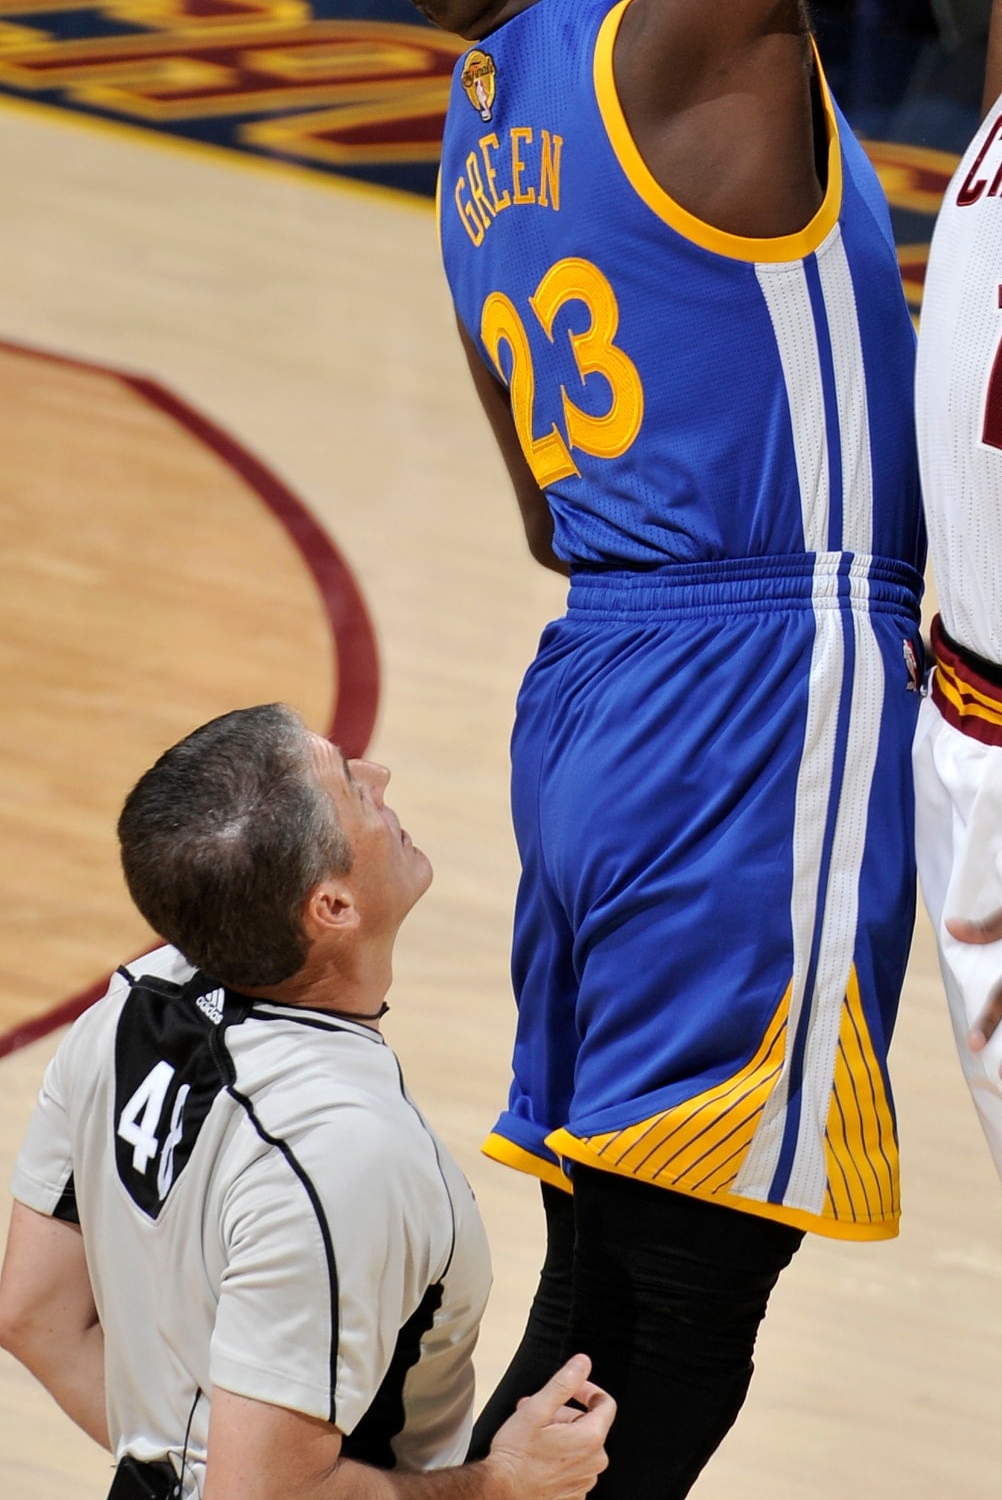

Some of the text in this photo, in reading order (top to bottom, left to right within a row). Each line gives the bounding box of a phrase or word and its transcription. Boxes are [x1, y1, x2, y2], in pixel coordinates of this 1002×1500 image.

[455, 127, 564, 248] GREEN
[480, 256, 645, 490] 23
[195, 995, 224, 1026] adidas
